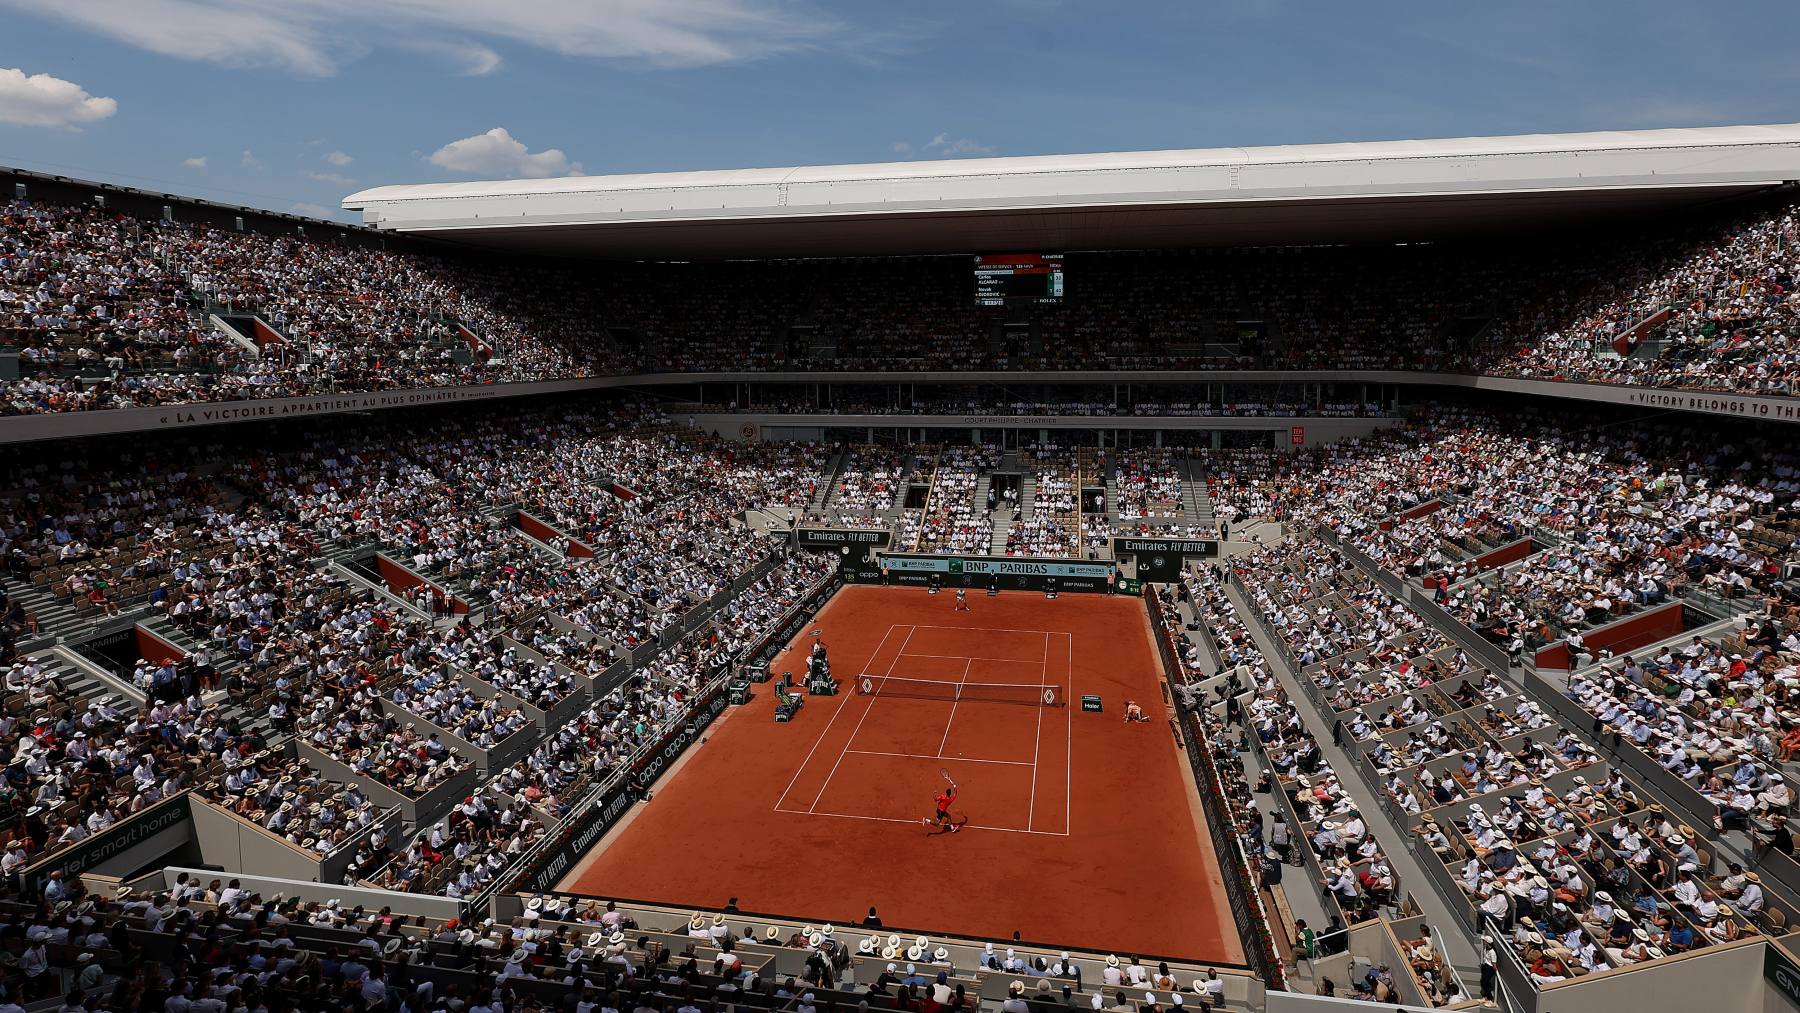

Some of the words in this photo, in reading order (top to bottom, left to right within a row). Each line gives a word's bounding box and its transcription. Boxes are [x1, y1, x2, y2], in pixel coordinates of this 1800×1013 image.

[177, 412, 196, 423] LA
[203, 406, 275, 420] VICTOIRE
[282, 399, 357, 414] APPARTIENT
[362, 397, 376, 407] AU
[381, 395, 404, 406] PLUS
[1639, 393, 1684, 407] VICTORY
[1689, 398, 1745, 413] BELONGS
[1752, 403, 1769, 416] TO
[808, 531, 845, 541] Emirates
[848, 532, 858, 541] FLY
[858, 533, 879, 542] BETTER
[1125, 540, 1167, 551] Emirates
[1170, 541, 1182, 551] FLY
[1182, 542, 1206, 552] BETTER
[966, 562, 989, 572] BNP
[1000, 563, 1048, 574] PARIBAS
[664, 733, 686, 758] oppo
[639, 756, 663, 783] oppo
[571, 818, 604, 854] Emirates
[603, 809, 613, 823] FLY
[610, 792, 627, 815] BETTER
[36, 856, 87, 892] Hier
[90, 827, 137, 862] smart
[139, 808, 181, 834] home
[537, 871, 549, 889] FLY
[547, 852, 568, 880] BETTER
